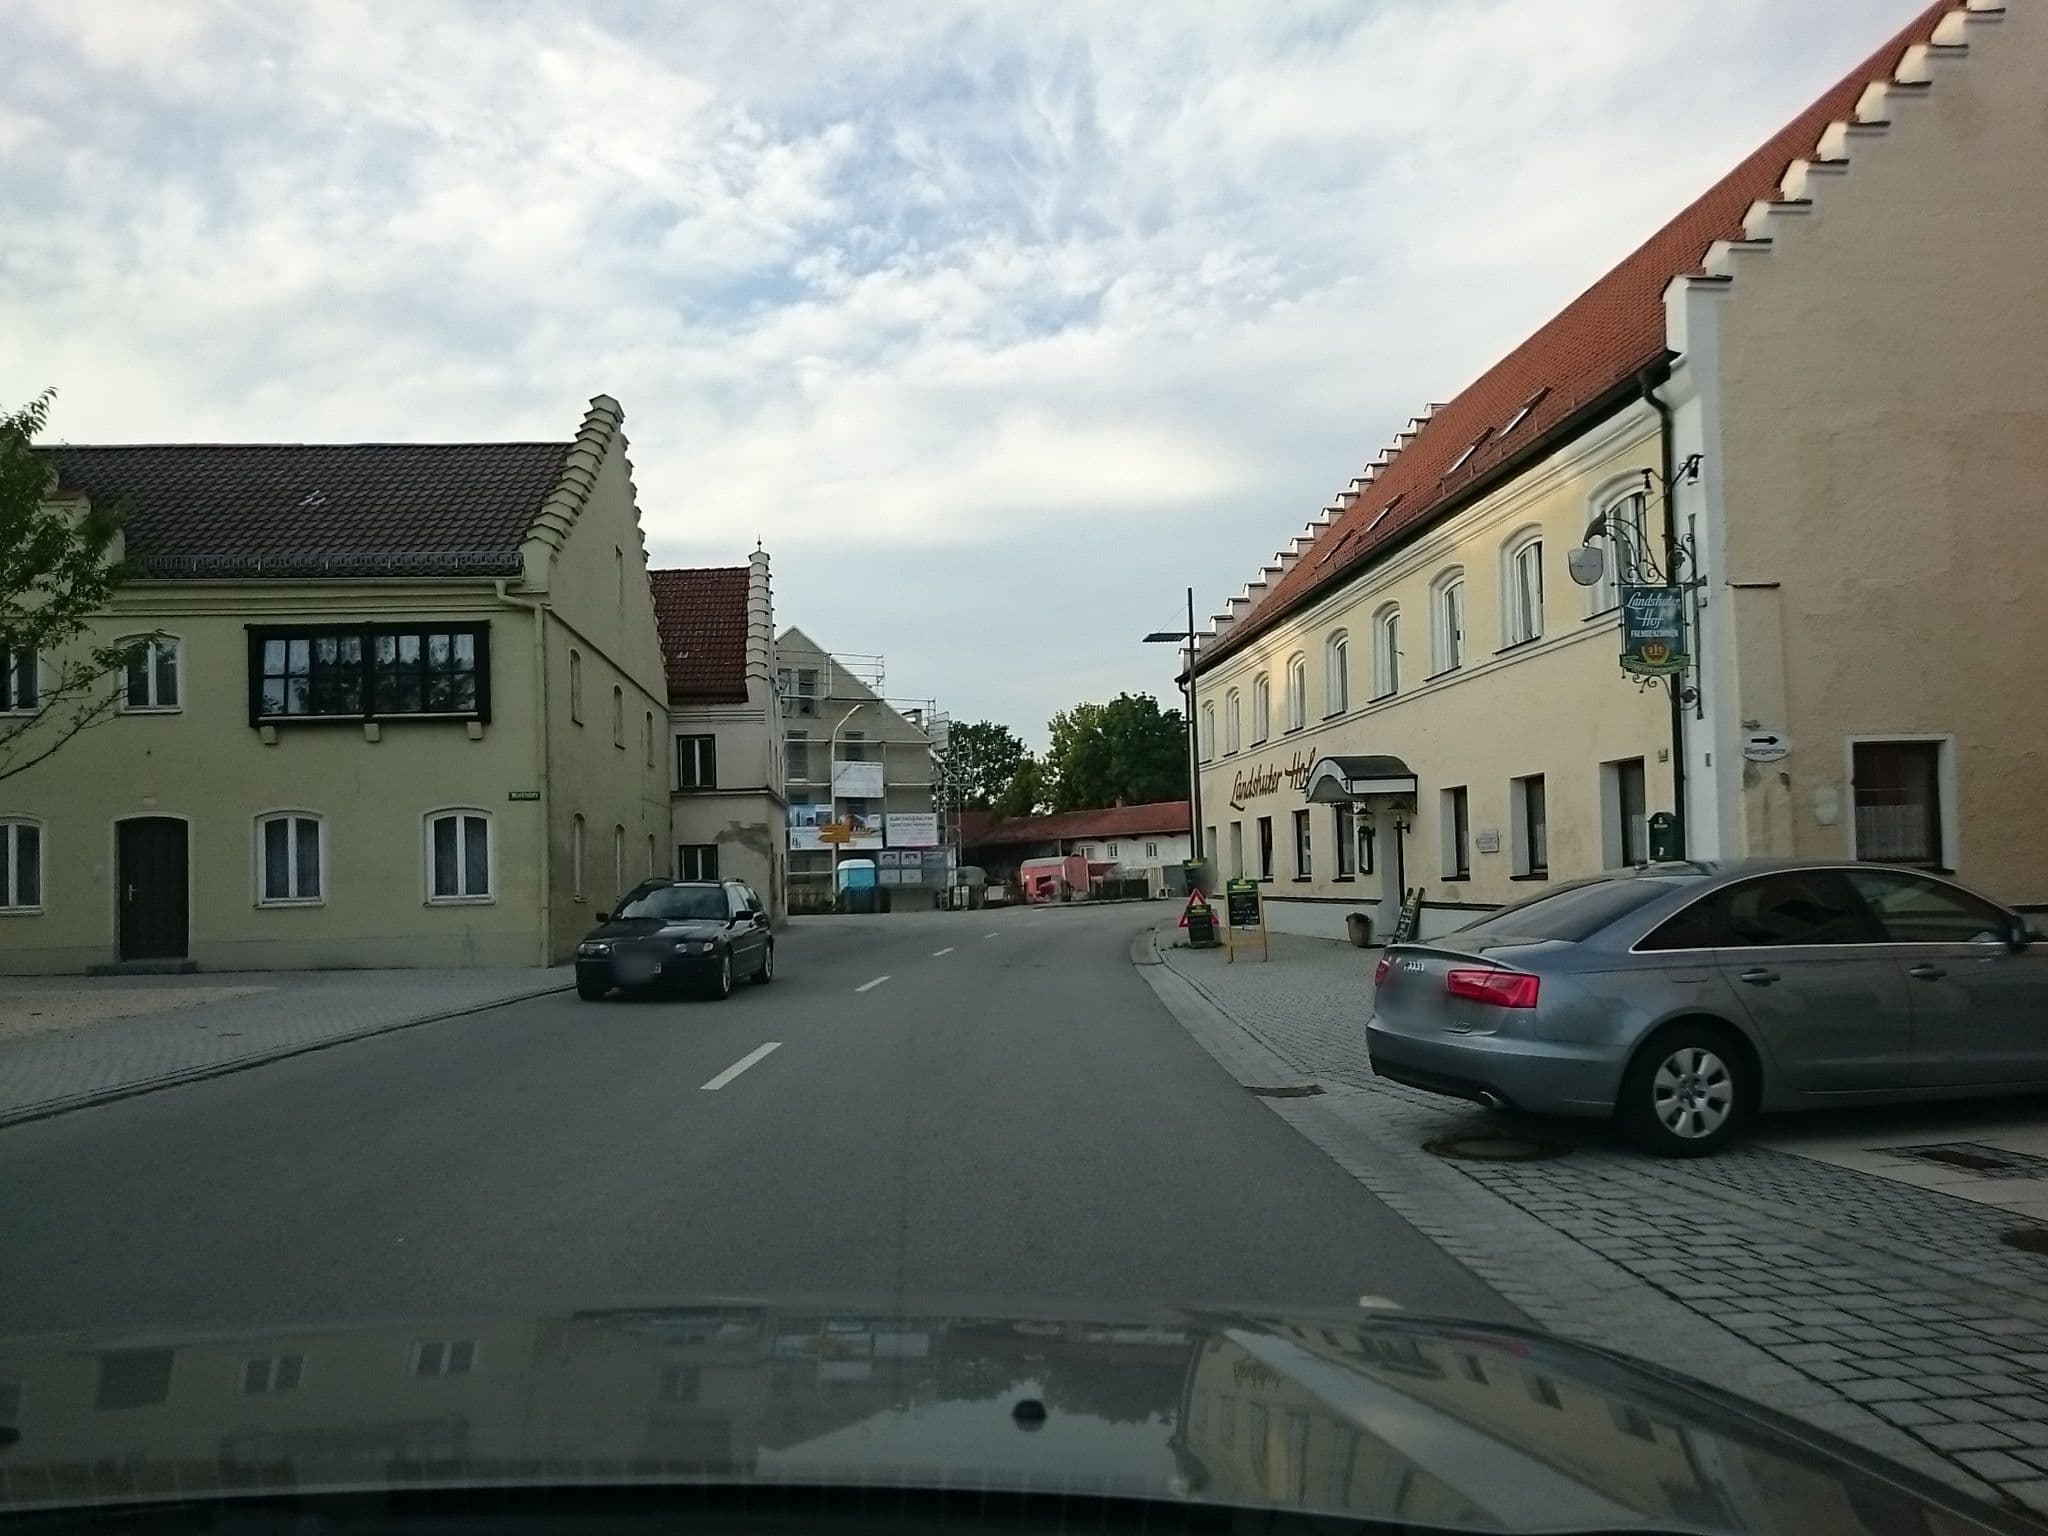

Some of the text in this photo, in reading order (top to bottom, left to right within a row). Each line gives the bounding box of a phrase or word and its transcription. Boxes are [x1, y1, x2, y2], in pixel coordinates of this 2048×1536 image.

[1636, 608, 1665, 629] Hof
[1229, 746, 1317, 812] Landshuter Hof
